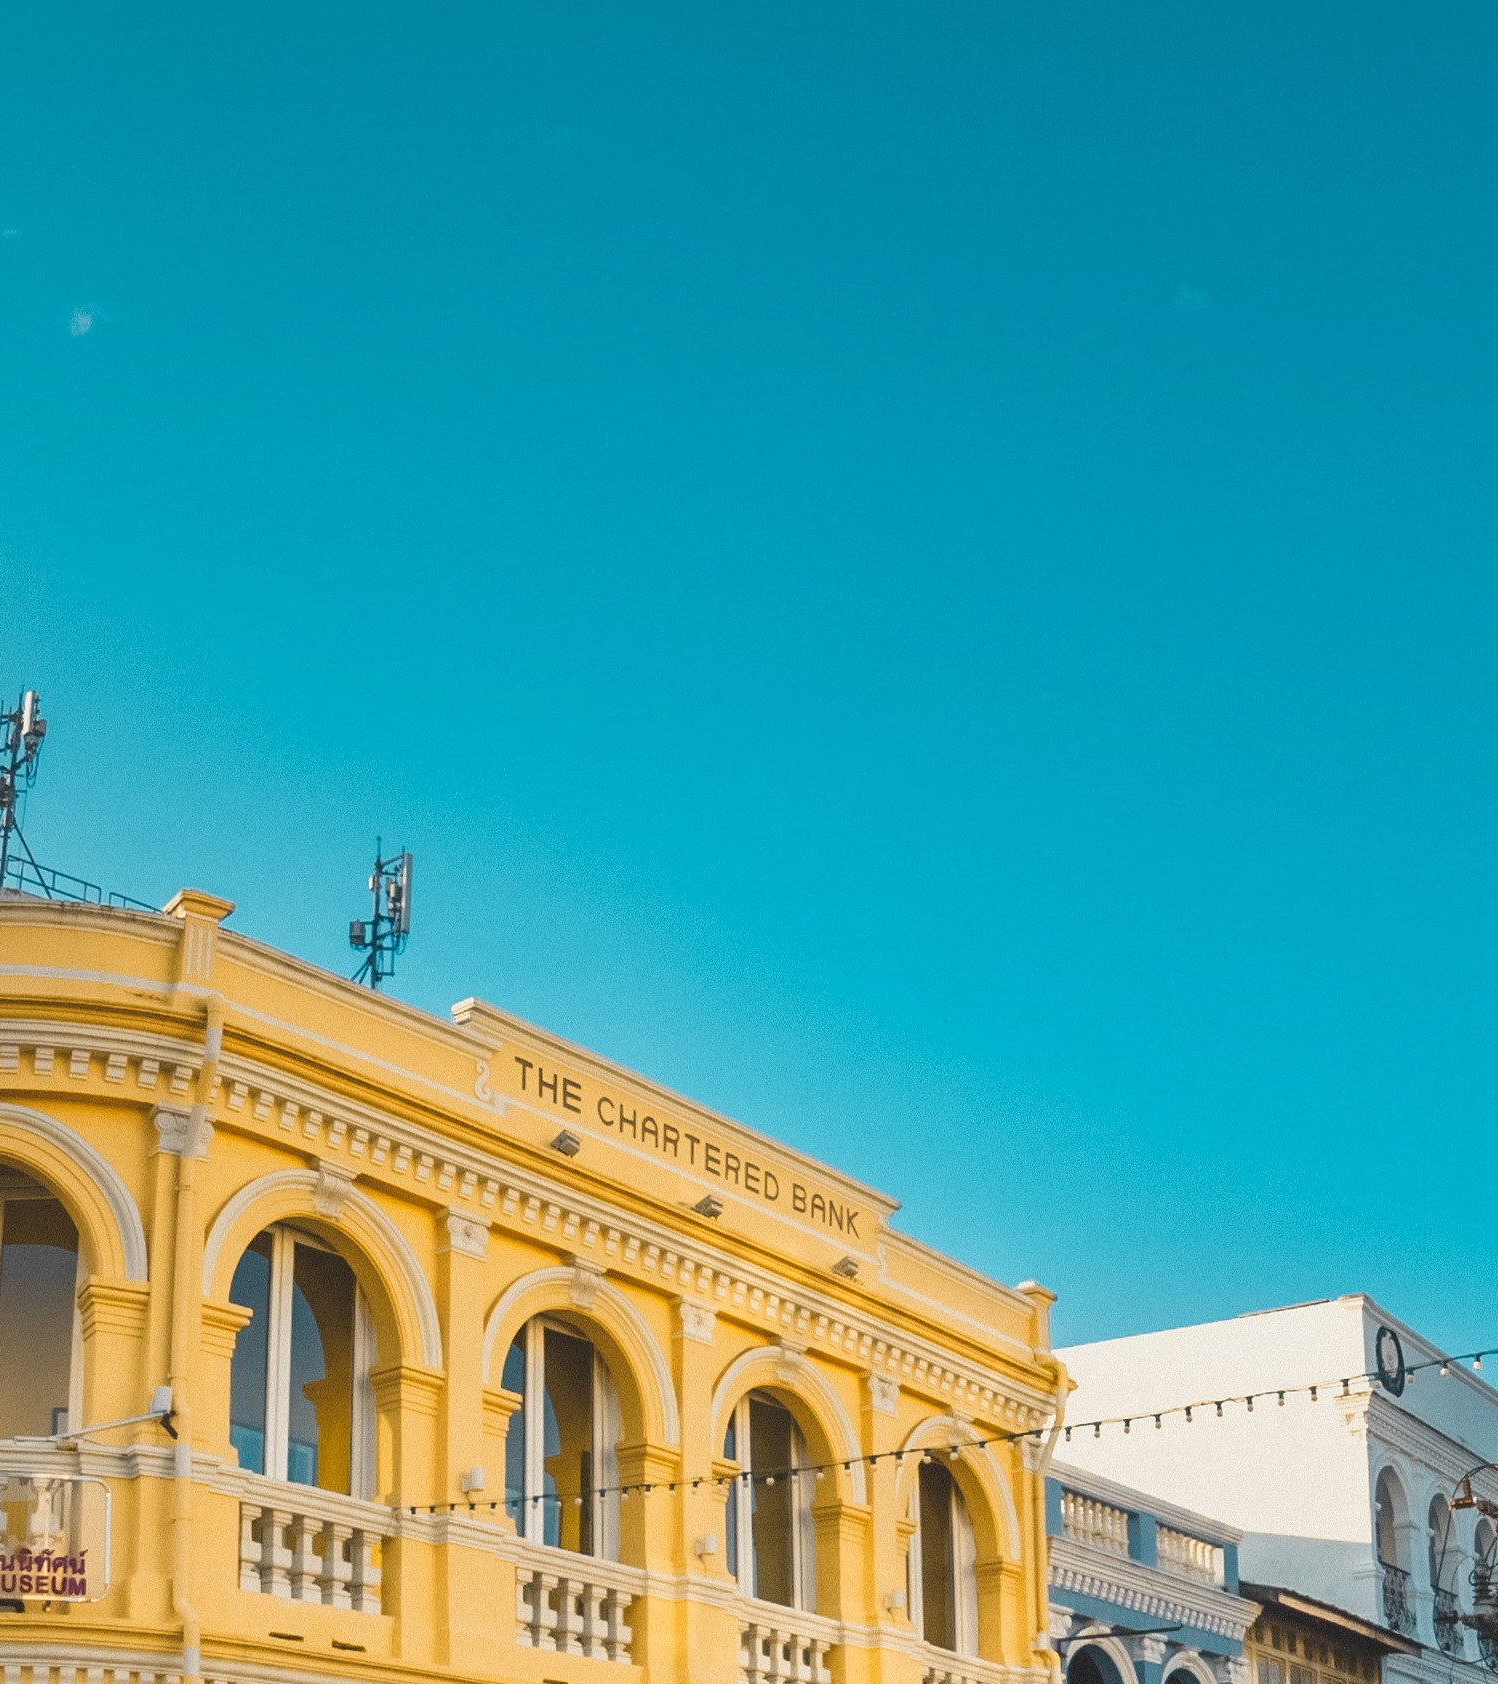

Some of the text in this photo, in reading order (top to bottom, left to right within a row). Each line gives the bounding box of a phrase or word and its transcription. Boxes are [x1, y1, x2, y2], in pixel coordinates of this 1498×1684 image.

[513, 1055, 861, 1240] THE CHARTERED BANK
